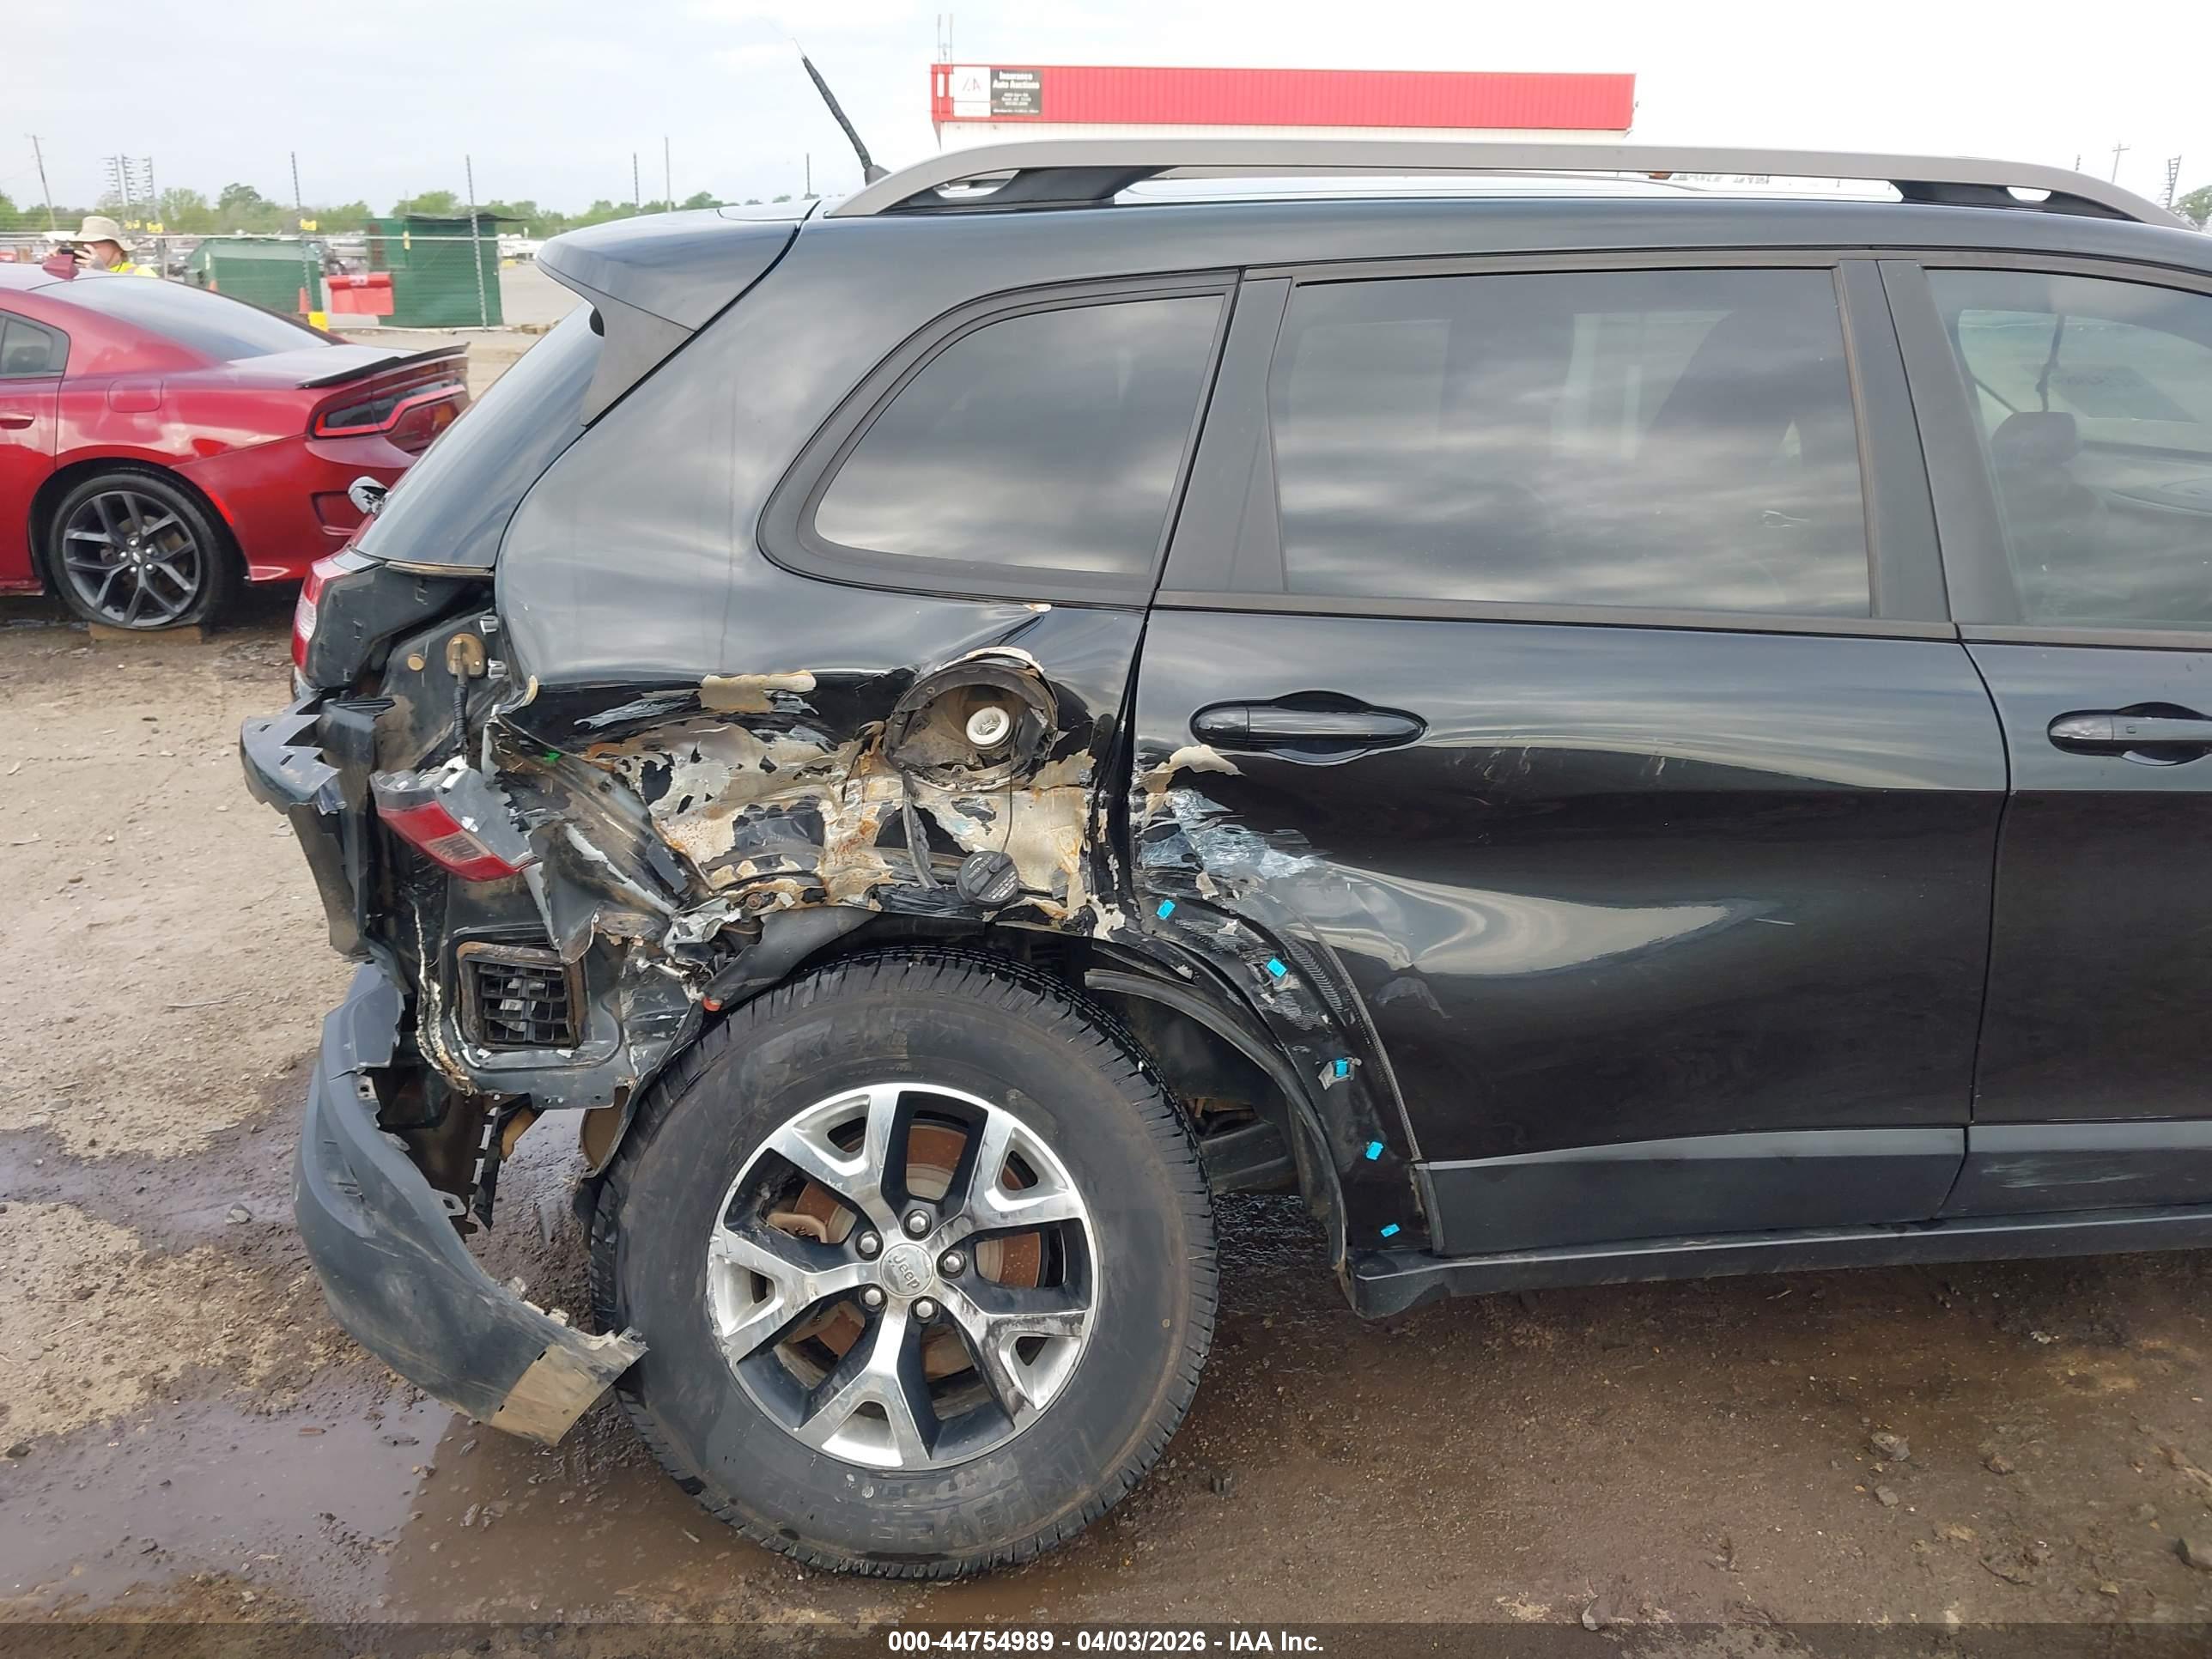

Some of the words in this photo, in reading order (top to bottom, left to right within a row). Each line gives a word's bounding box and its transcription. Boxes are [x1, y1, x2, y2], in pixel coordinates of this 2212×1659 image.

[993, 79, 1009, 88] Auto
[1010, 80, 1040, 89] Auctions
[893, 1255, 921, 1290] Jeep
